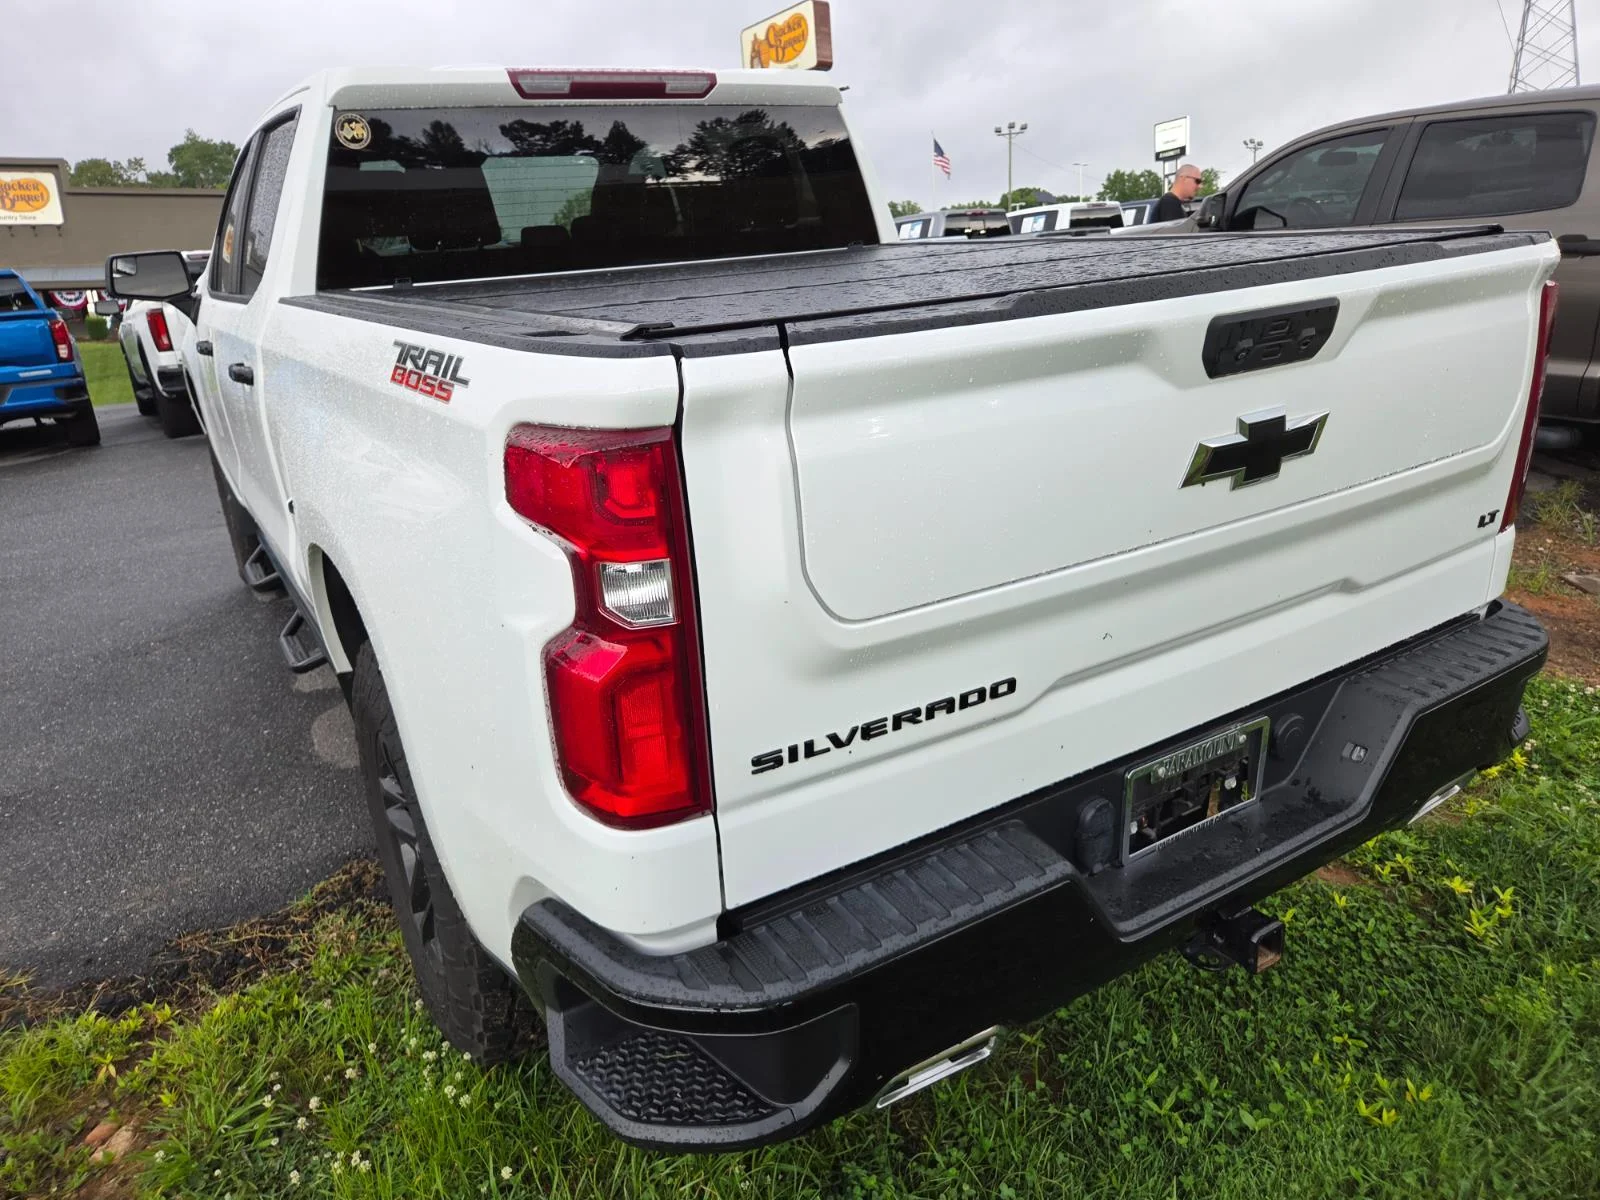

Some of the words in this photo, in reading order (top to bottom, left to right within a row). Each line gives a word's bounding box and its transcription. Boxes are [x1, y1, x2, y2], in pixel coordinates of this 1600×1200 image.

[0, 214, 18, 222] ountry
[390, 364, 454, 404] BOSS
[393, 339, 471, 388] TRAIL
[1477, 509, 1500, 528] LT
[751, 677, 1017, 775] SILVERADO
[1162, 731, 1241, 777] PARAMOUNT
